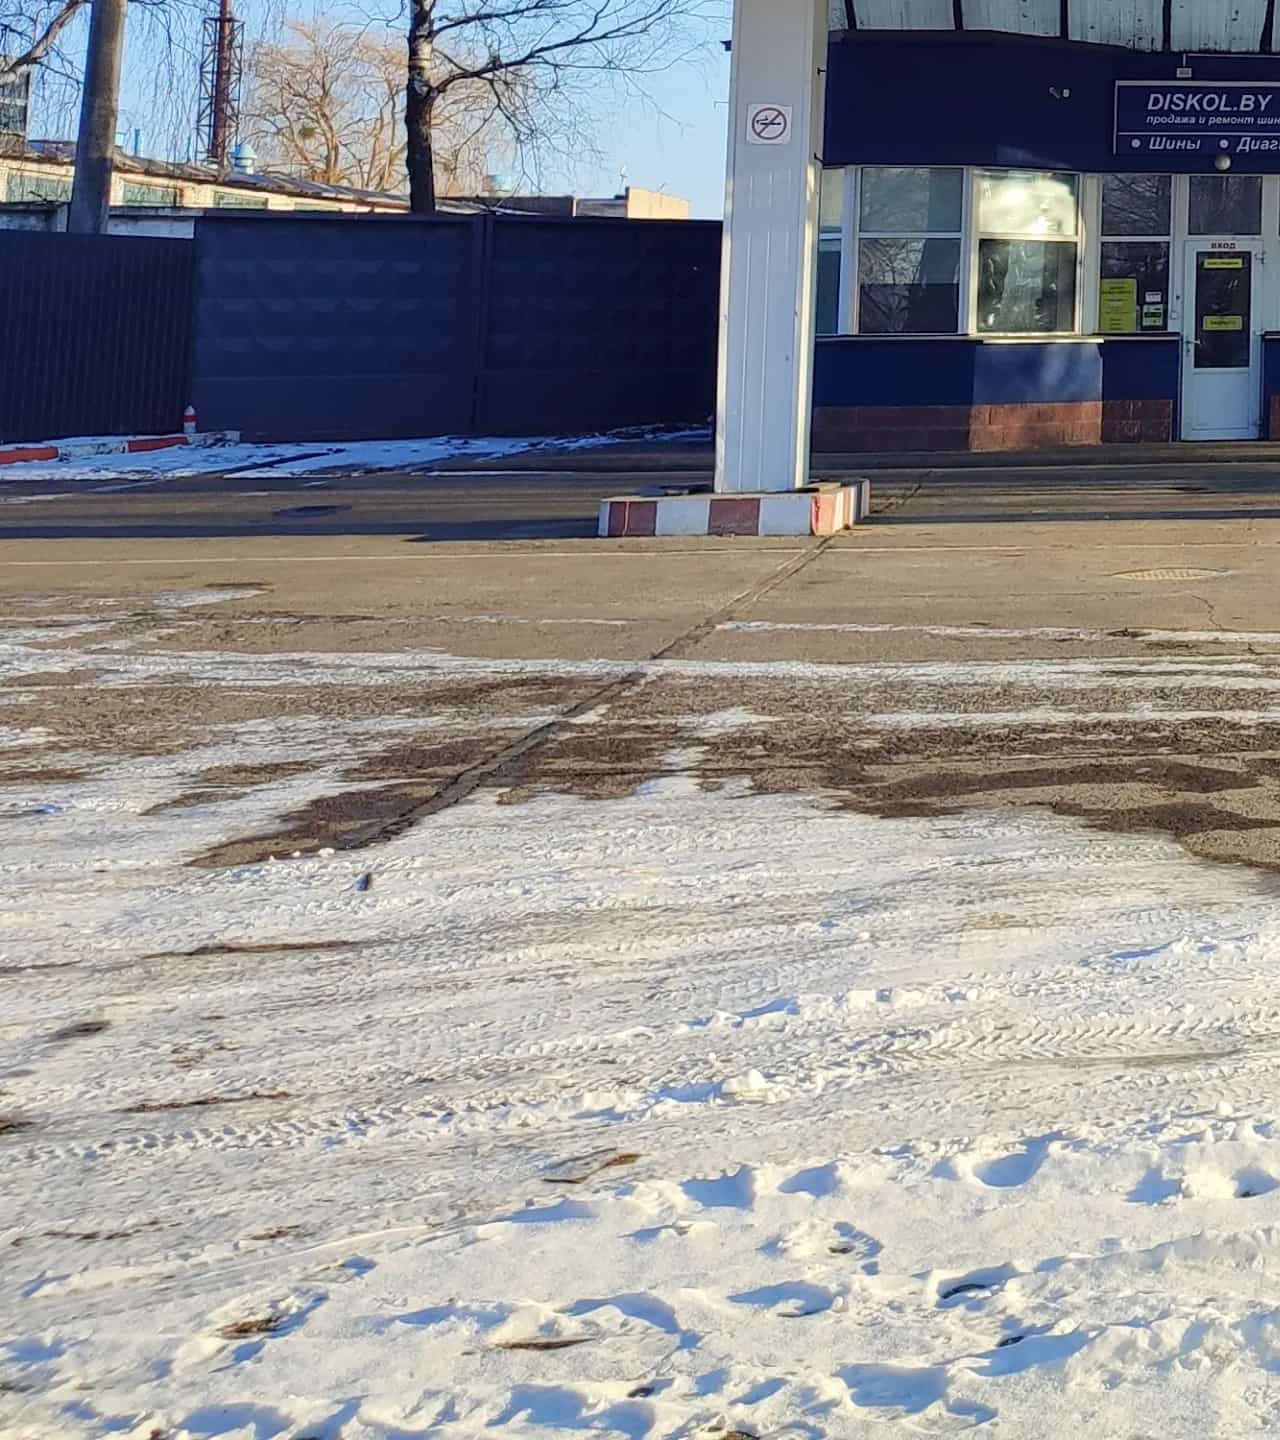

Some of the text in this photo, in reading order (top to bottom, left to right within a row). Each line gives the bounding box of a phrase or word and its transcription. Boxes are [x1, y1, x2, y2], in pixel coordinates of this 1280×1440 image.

[1147, 93, 1272, 111] DISKOL.BY
[1146, 114, 1280, 126] продажа и ремонт шин
[1149, 137, 1200, 150] Шины
